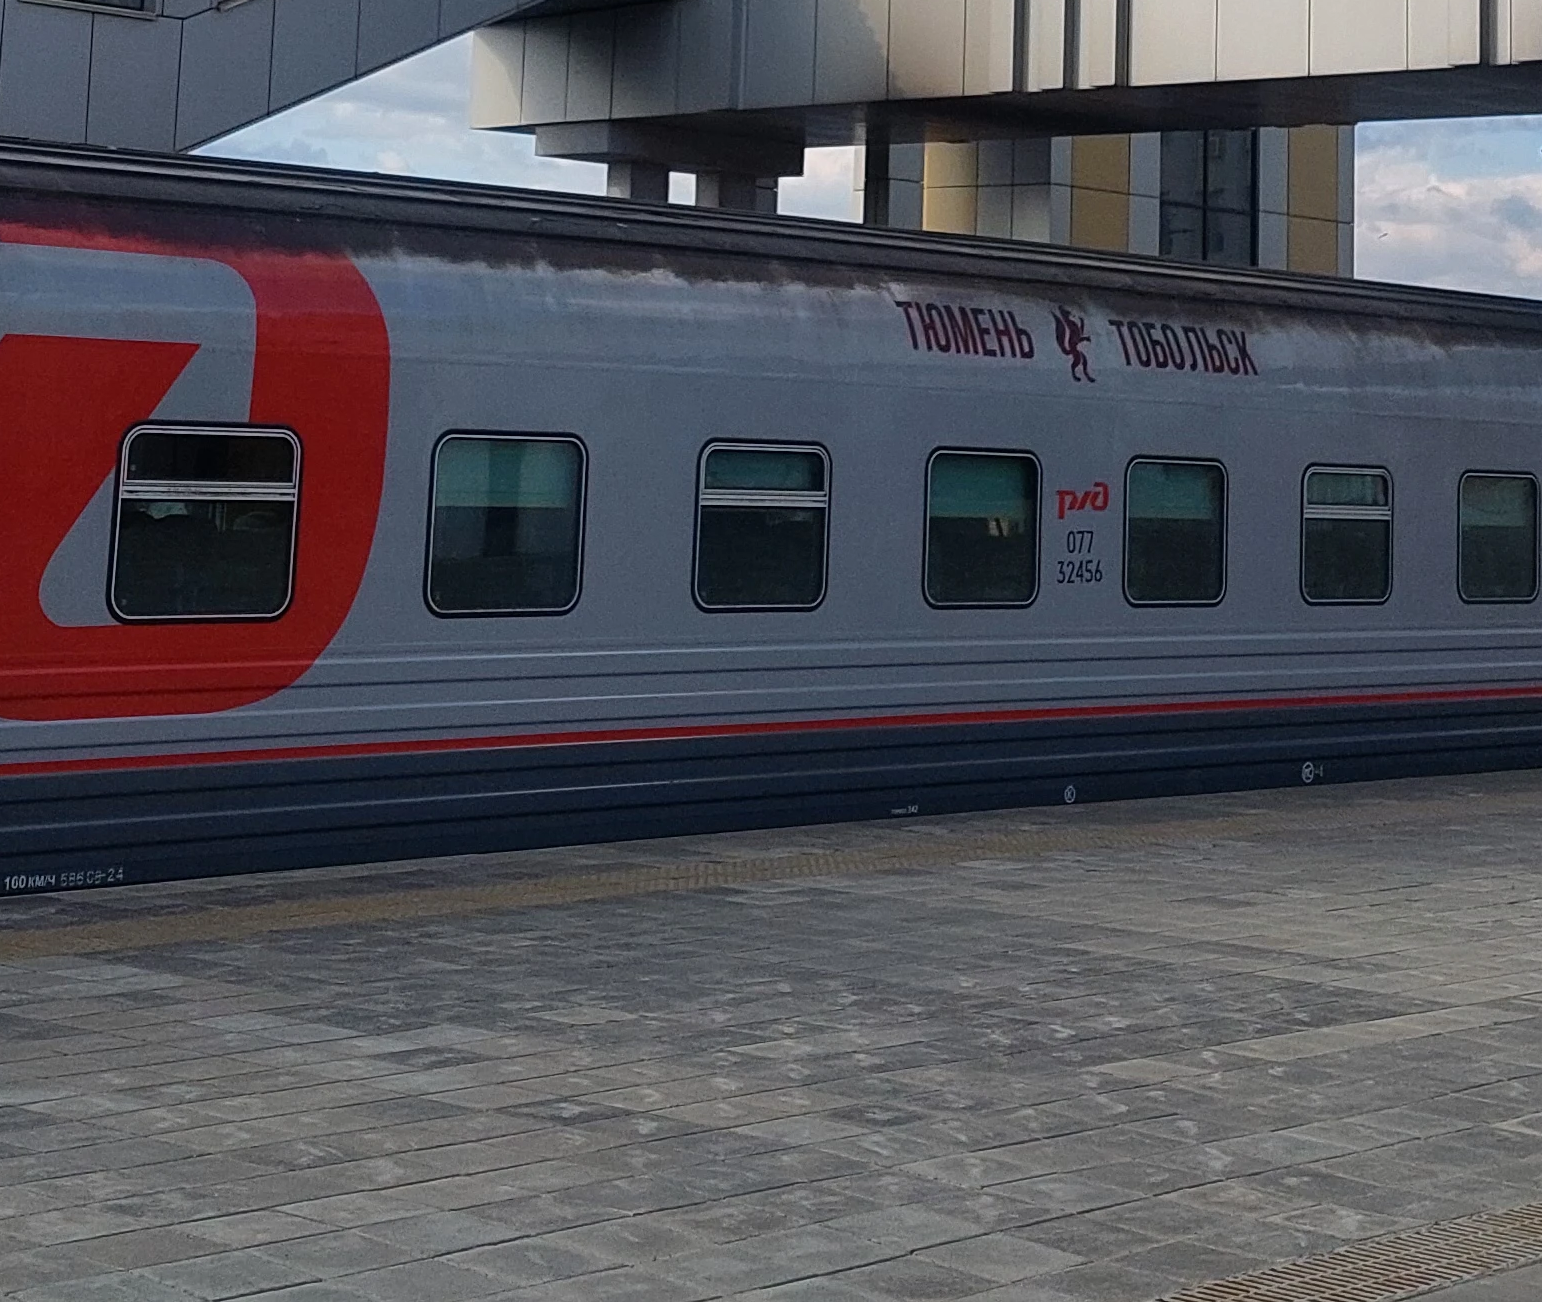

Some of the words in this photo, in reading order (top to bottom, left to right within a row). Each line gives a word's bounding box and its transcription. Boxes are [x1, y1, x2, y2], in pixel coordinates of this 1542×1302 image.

[894, 300, 1035, 359] ТЮМЕНЬ
[1108, 319, 1258, 376] ТОБОЛЬСК
[1066, 530, 1094, 554] 077
[1056, 560, 1103, 584] 32456
[4, 875, 26, 891] 100
